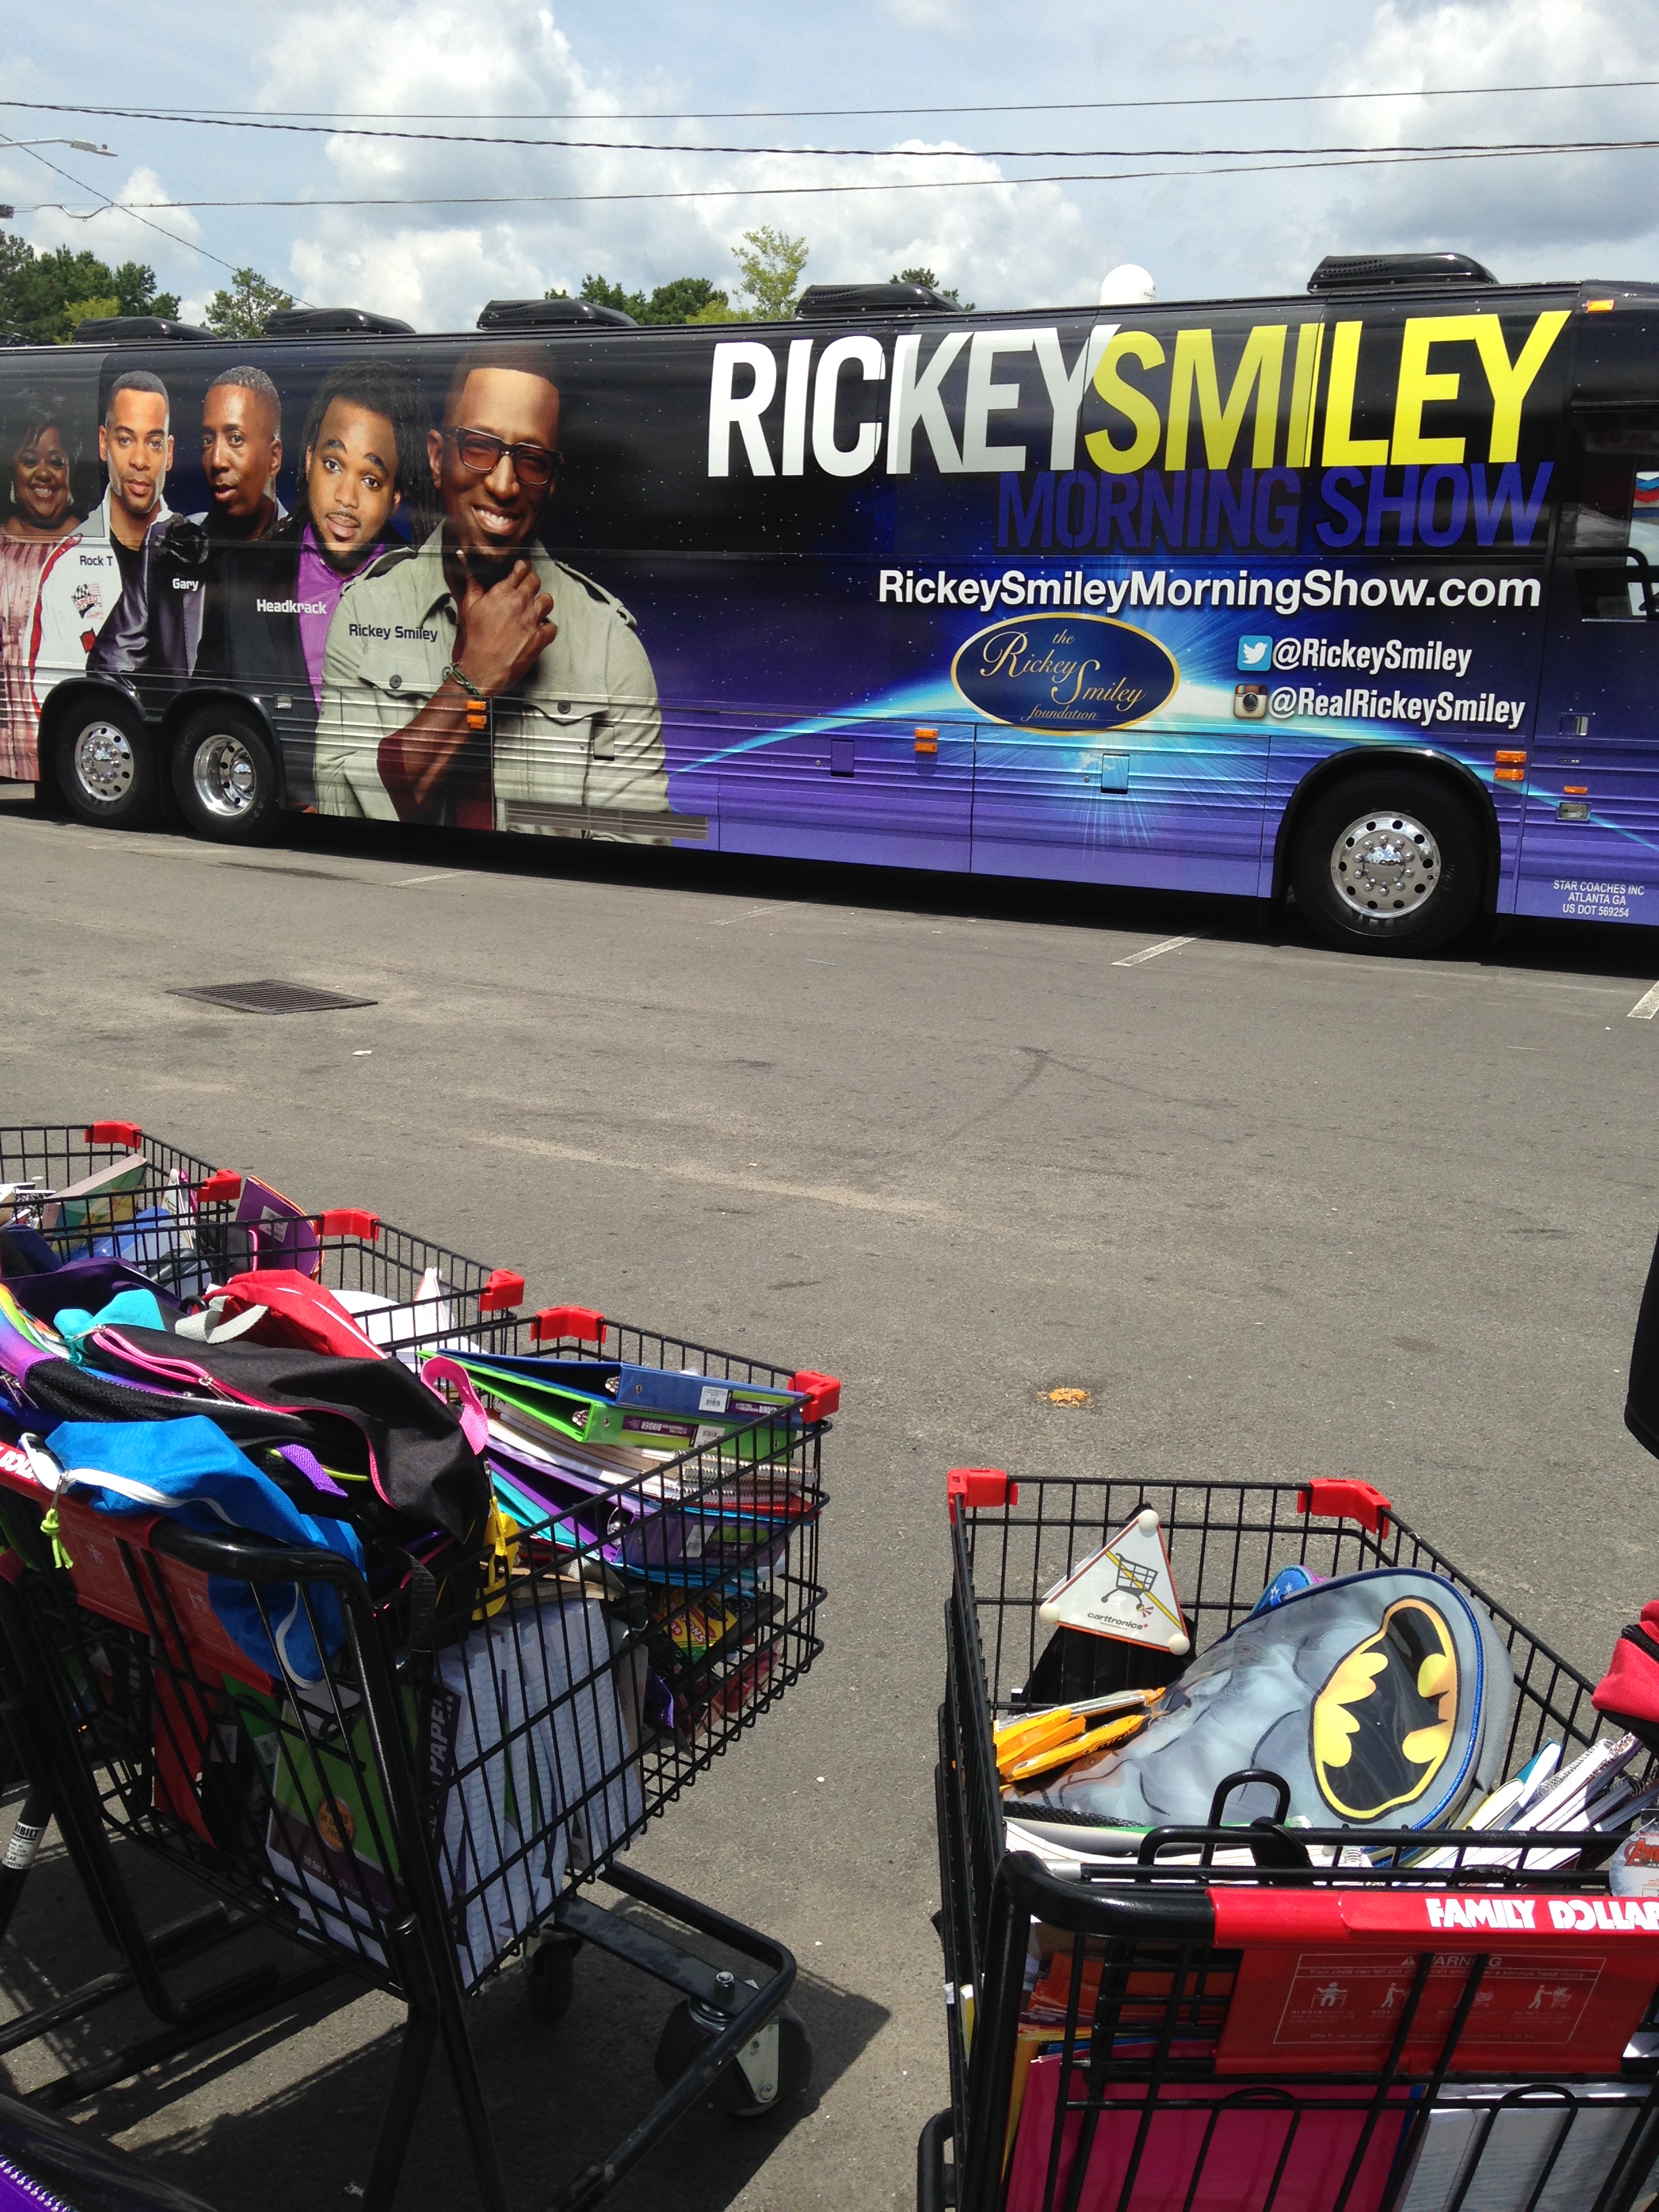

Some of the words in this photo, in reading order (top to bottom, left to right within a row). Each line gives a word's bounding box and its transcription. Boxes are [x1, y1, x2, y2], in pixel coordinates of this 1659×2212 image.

[997, 466, 1301, 549] MORNING
[1315, 462, 1554, 548] SHOW
[79, 555, 104, 566] Rock
[106, 556, 113, 566] T
[172, 578, 199, 592] Gary
[879, 569, 1541, 614] RickeySmileyMorningShow.com
[76, 595, 98, 609] SPEED
[256, 599, 327, 615] Headkrack
[349, 623, 391, 639] Rickey
[395, 626, 438, 642] Smiley
[1052, 629, 1076, 644] the
[980, 631, 1082, 684] Rickey
[1273, 638, 1473, 677] @RickeySmiley
[1051, 659, 1146, 712] Smiley
[1020, 703, 1098, 722] foundation
[1269, 687, 1526, 730] @RealRickeySmiley
[1553, 880, 1578, 891] STAR
[1580, 882, 1626, 895] COACHES
[1628, 885, 1645, 896] INC
[1568, 893, 1610, 904] ATLANTA
[1612, 895, 1626, 905] GA
[1563, 903, 1576, 914] US
[1578, 905, 1597, 915] DOT
[1598, 906, 1629, 918] 569254
[641, 1421, 662, 1431] BINDER
[1087, 1612, 1143, 1630] carttronics
[1425, 1898, 1536, 1929] FAMILY
